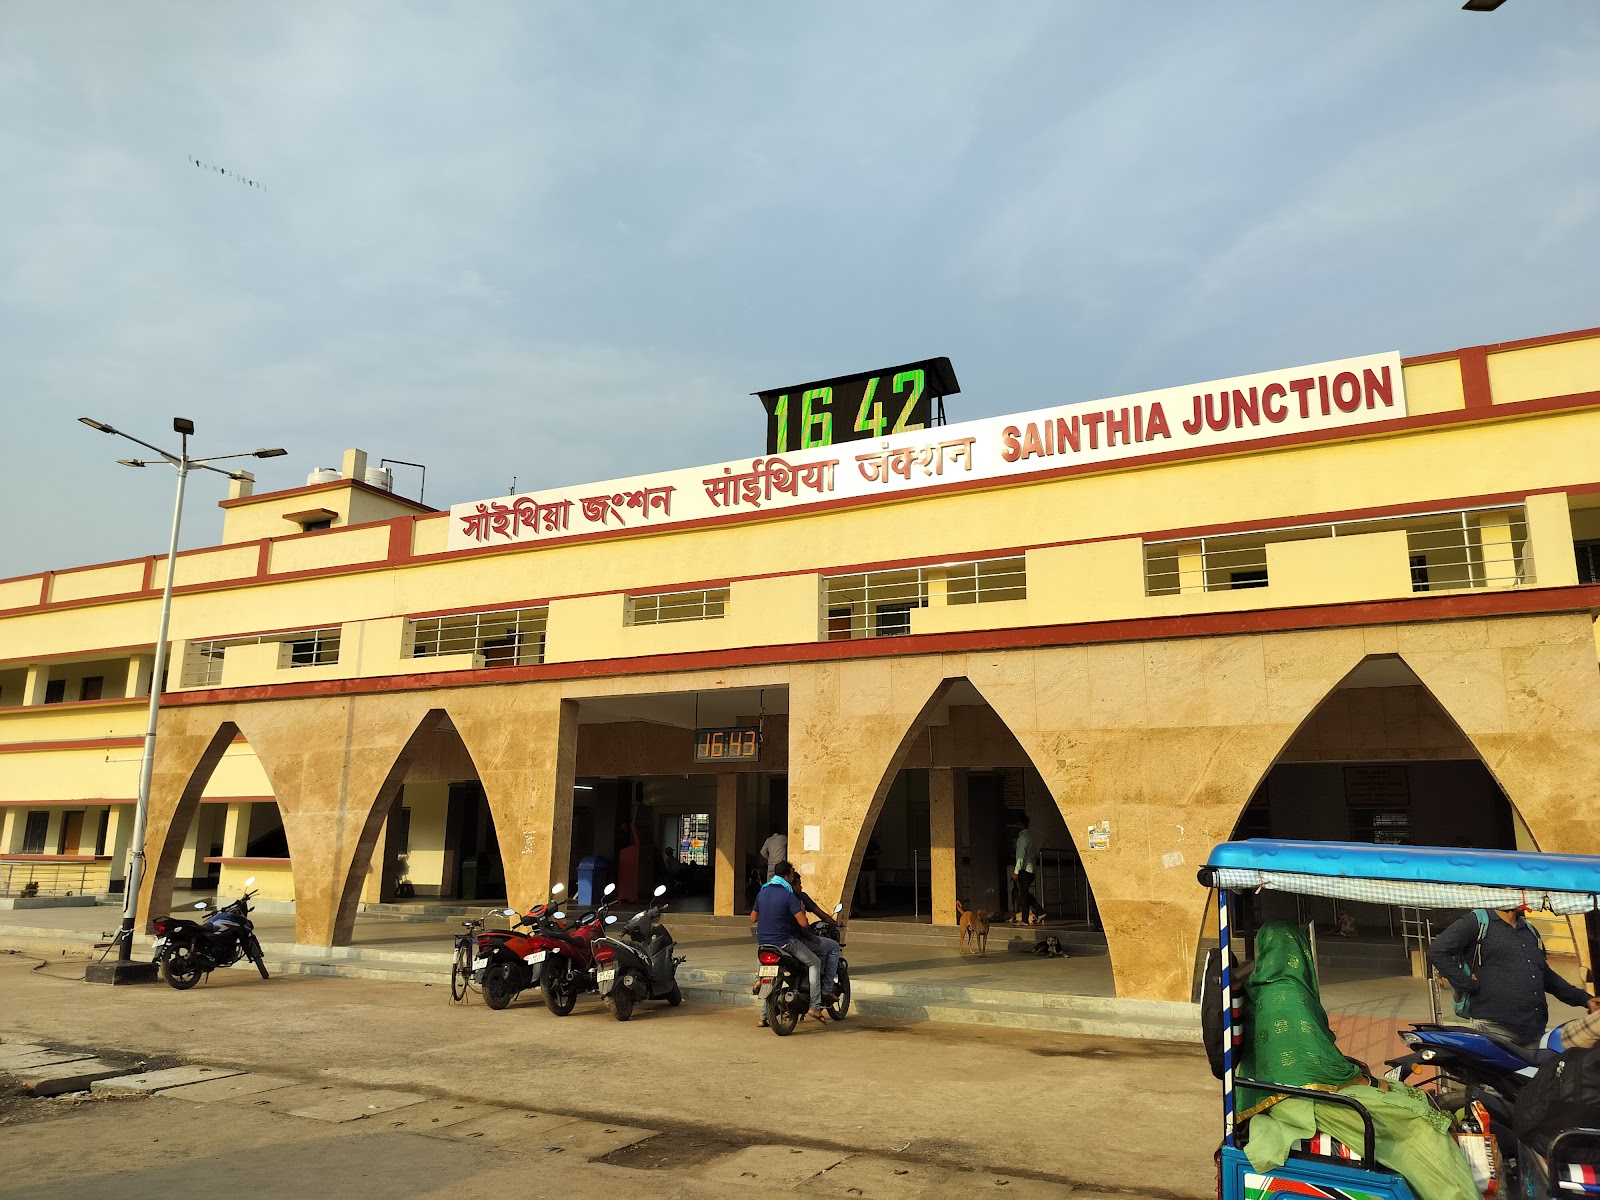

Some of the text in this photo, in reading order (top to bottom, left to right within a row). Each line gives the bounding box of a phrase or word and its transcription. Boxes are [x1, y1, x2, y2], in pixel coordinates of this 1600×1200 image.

[774, 369, 925, 454] 16 42
[1001, 365, 1394, 462] SAINTHIA JUNCTION
[579, 484, 677, 527] জংশন
[703, 436, 976, 507] सांईथिया जंक्शन
[704, 730, 756, 757] 16:43
